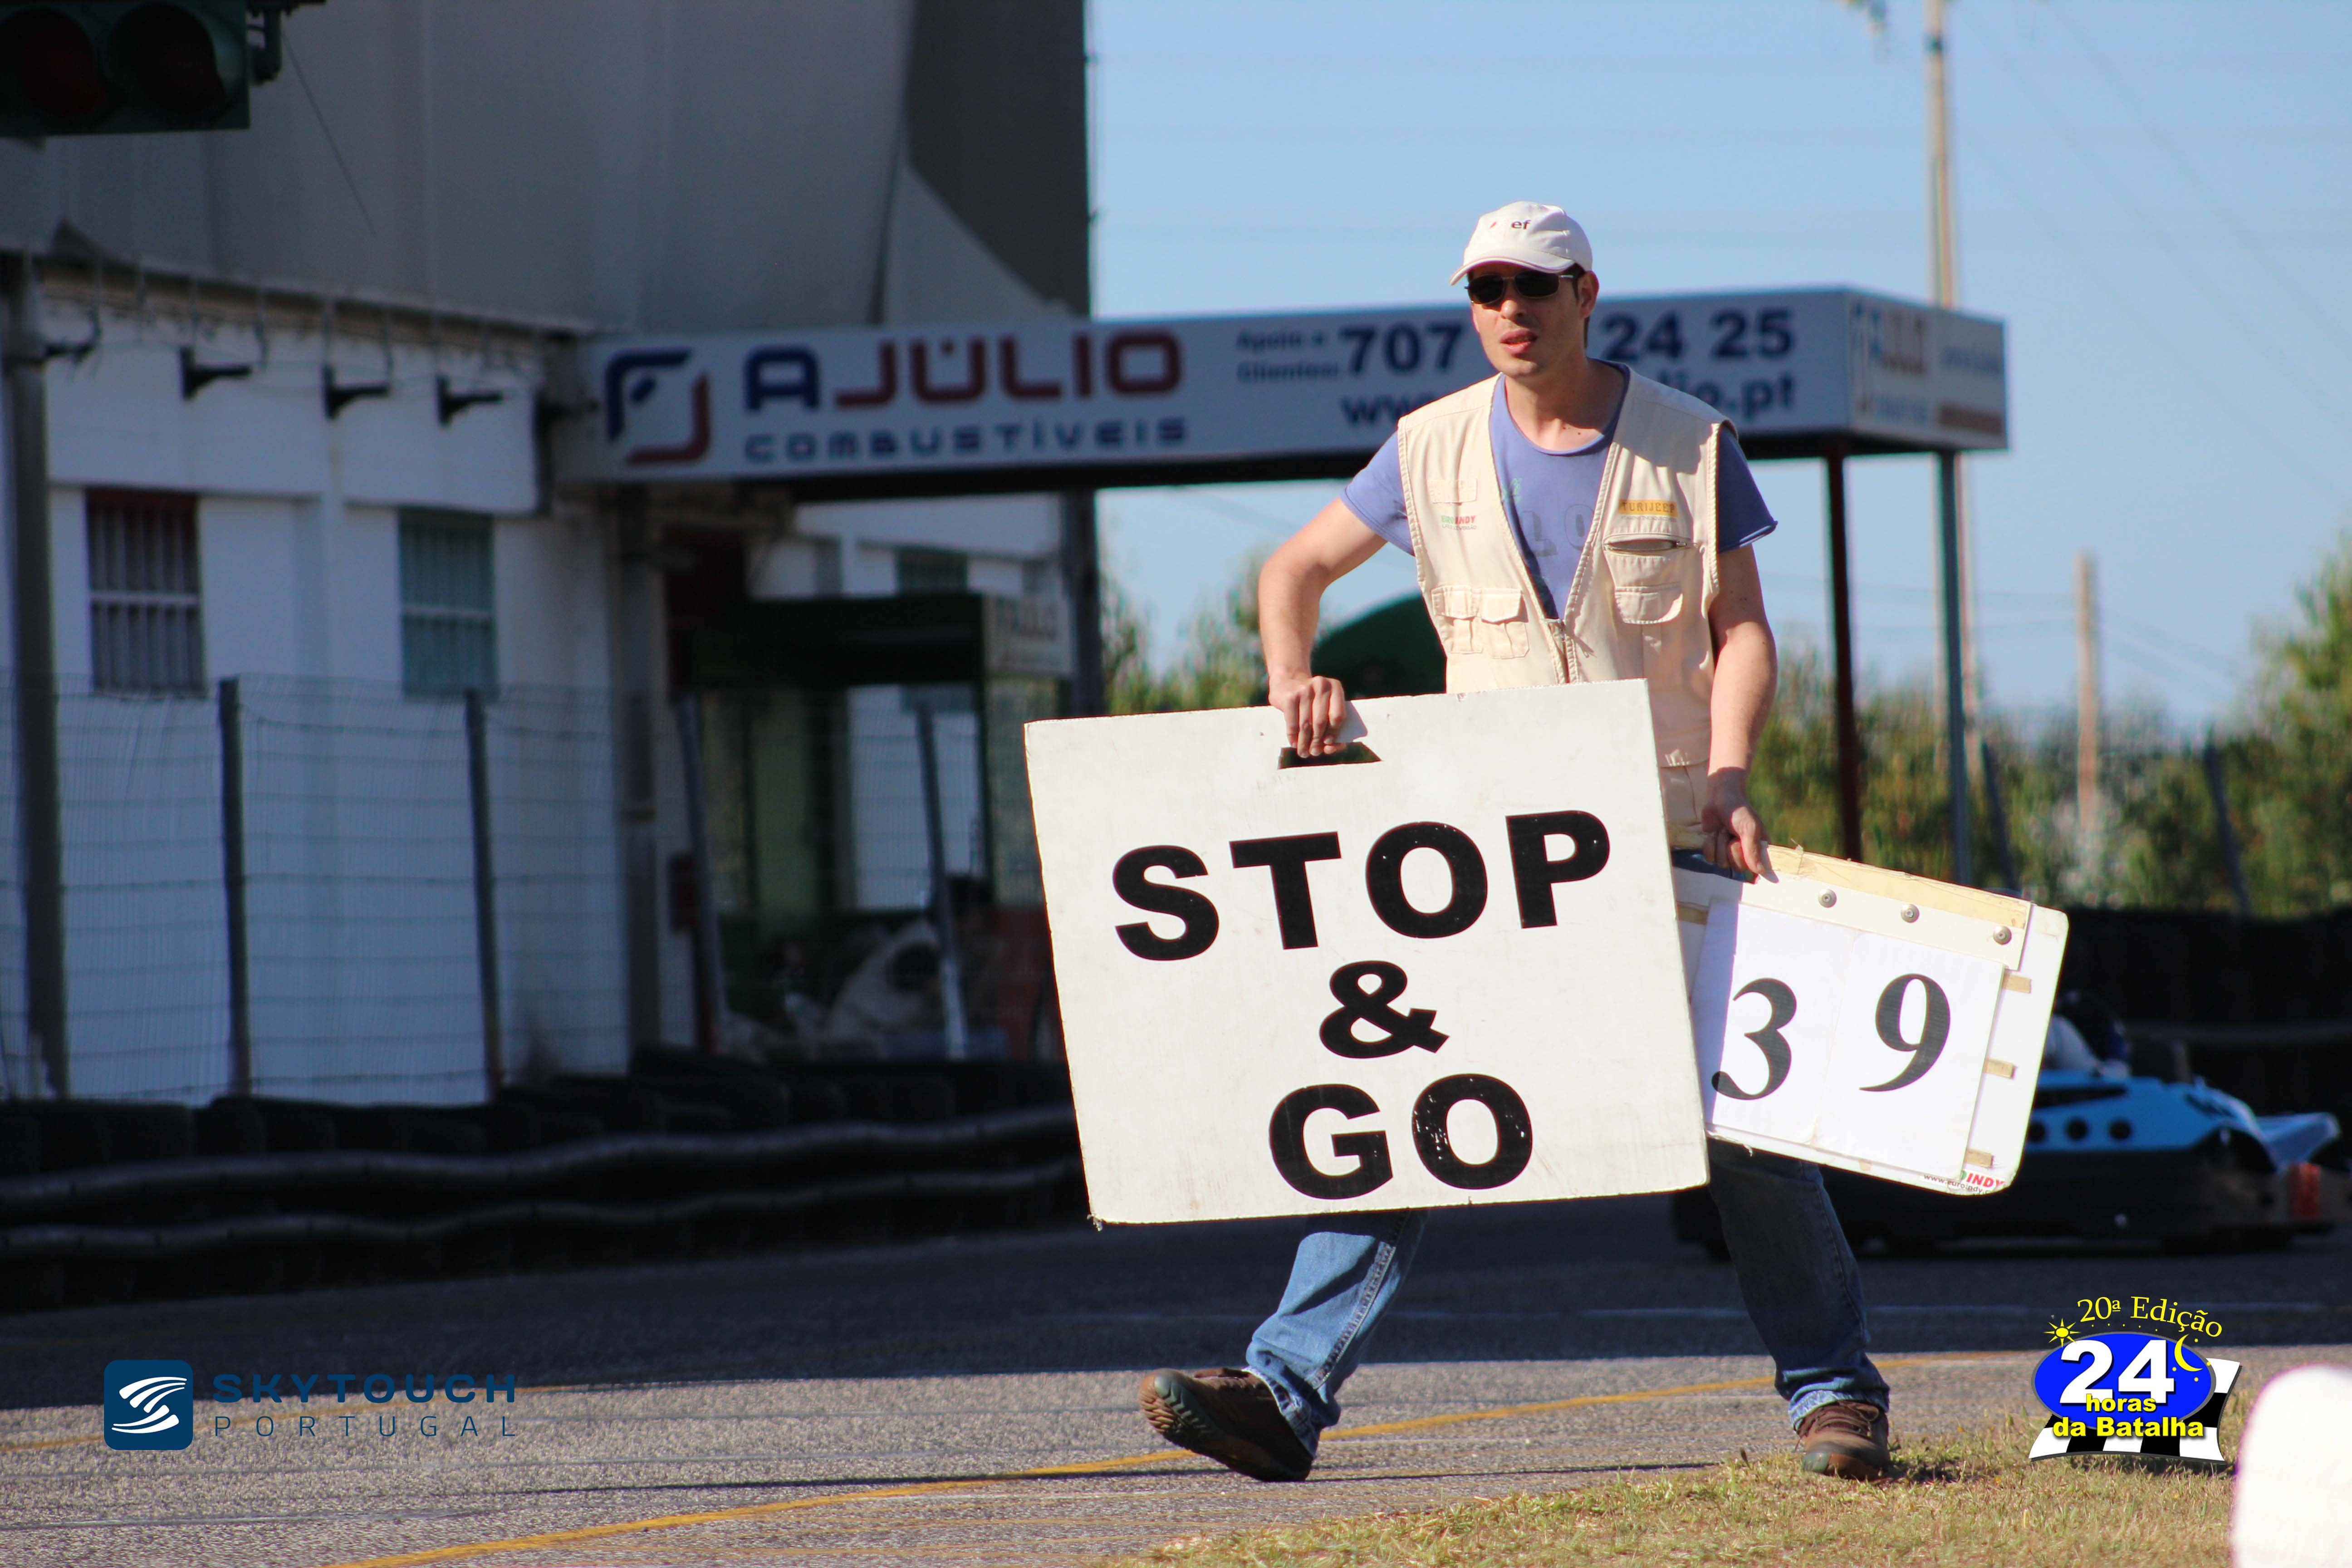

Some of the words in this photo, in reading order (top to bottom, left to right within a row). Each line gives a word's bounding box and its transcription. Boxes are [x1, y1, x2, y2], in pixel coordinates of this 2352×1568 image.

[1338, 323, 1464, 376] 707
[1601, 310, 1684, 363] 24
[1710, 307, 1794, 358] 25
[744, 415, 1189, 463] COMBUSTÍVEIS
[1112, 810, 1611, 961] STOP
[1319, 960, 1449, 1059] &
[1269, 1073, 1534, 1200] GO
